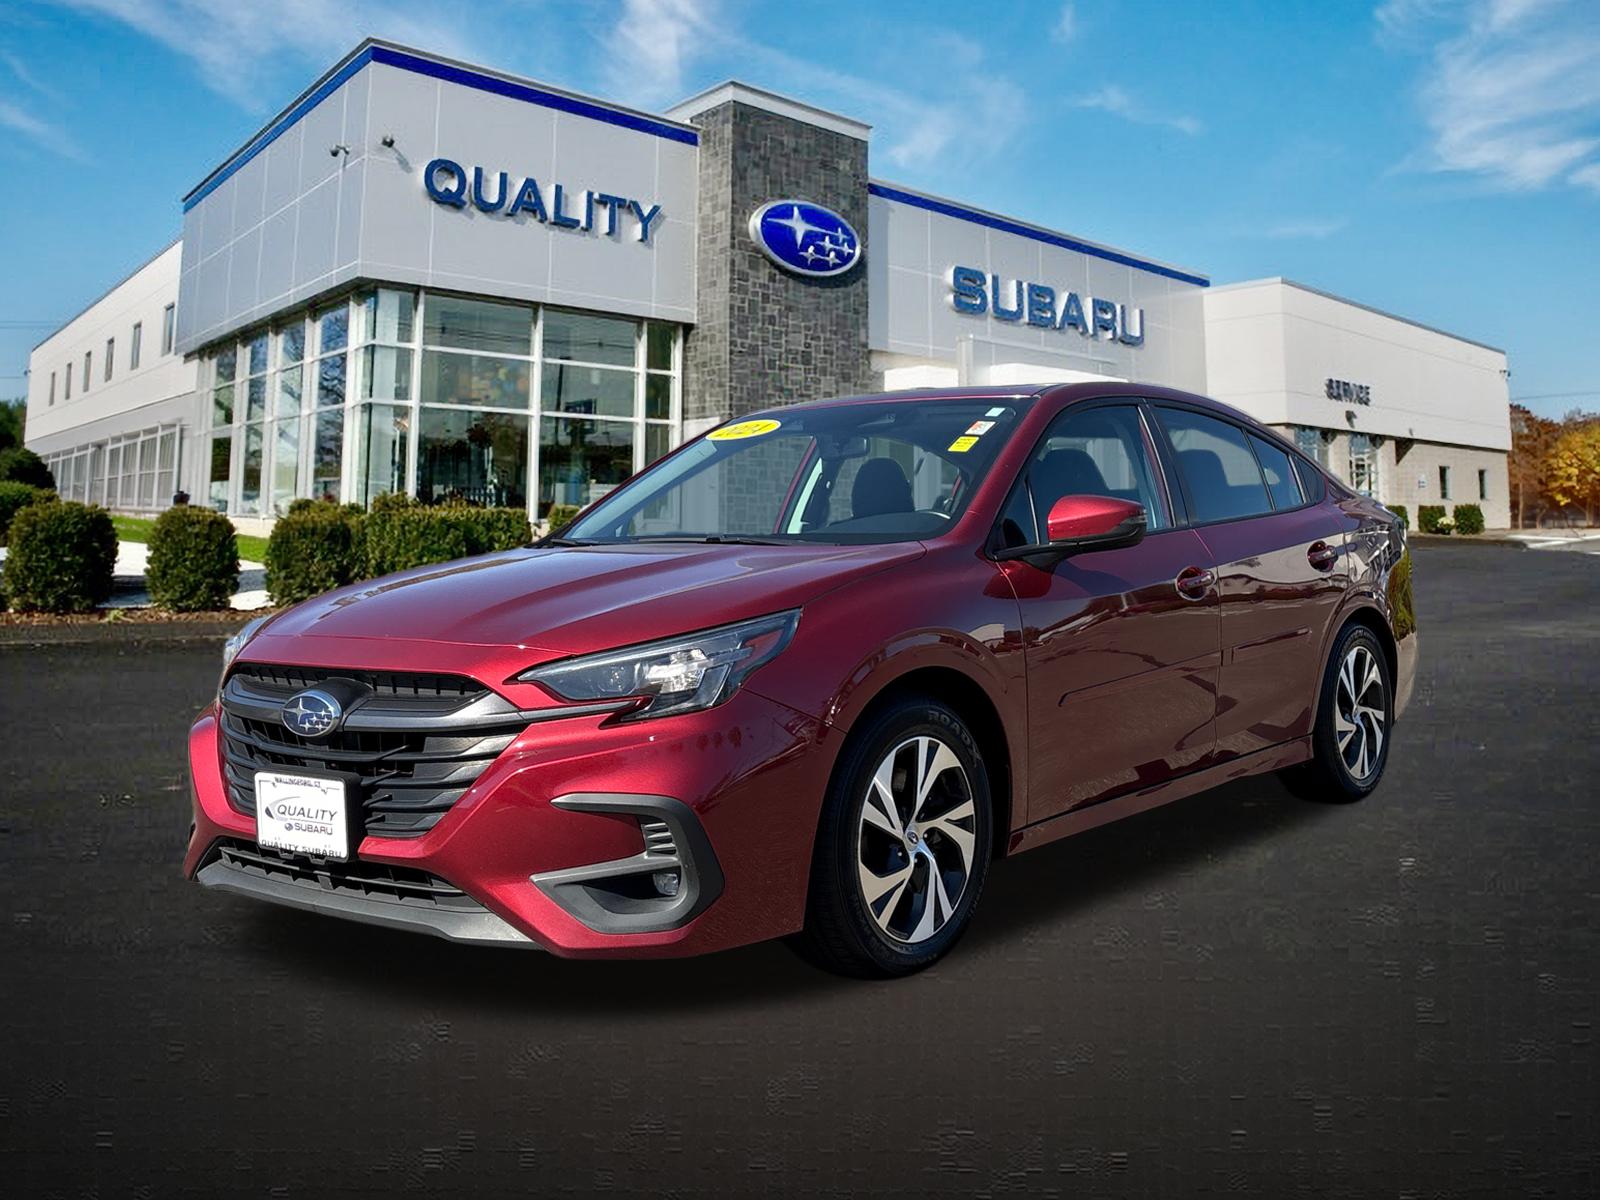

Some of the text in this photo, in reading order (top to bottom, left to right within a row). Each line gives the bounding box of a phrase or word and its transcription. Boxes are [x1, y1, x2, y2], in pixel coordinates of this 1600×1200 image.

[424, 158, 661, 243] QUALITY
[953, 265, 1145, 347] SUBARU
[1325, 378, 1370, 406] SERVICE
[277, 804, 338, 821] QUALITY
[294, 822, 333, 835] SUBARU
[261, 839, 299, 852] QUALITY
[302, 846, 341, 857] SUBARU
